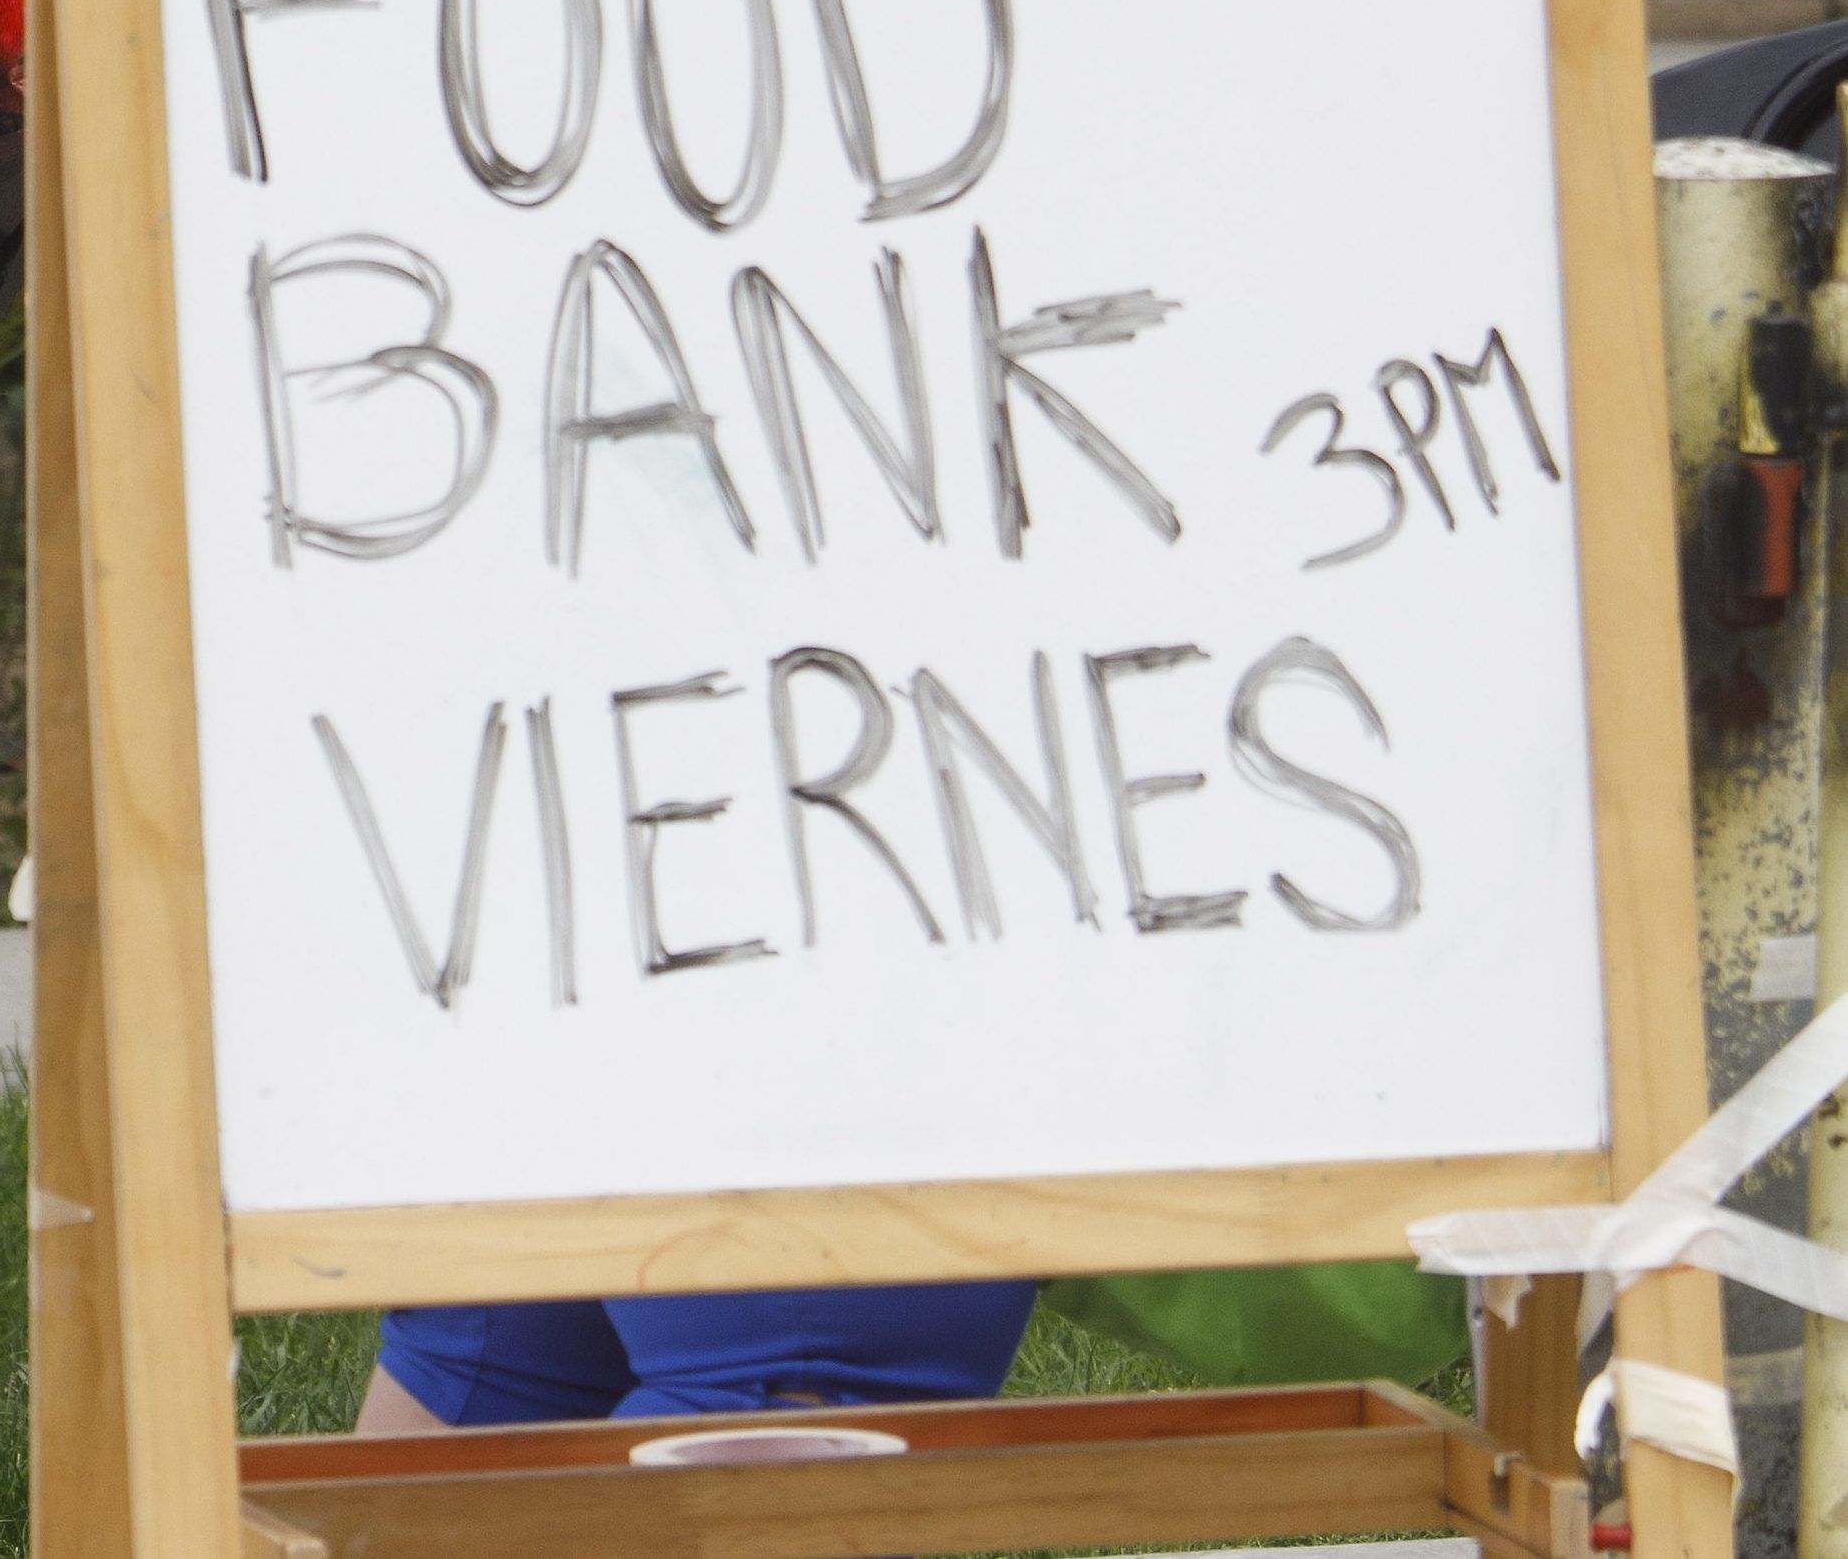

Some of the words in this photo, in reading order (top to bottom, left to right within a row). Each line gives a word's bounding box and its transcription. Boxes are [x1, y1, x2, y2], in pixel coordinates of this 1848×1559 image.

[250, 225, 1184, 579] BANK
[1259, 327, 1561, 571] 3PM
[312, 636, 1422, 1011] VIERNES
